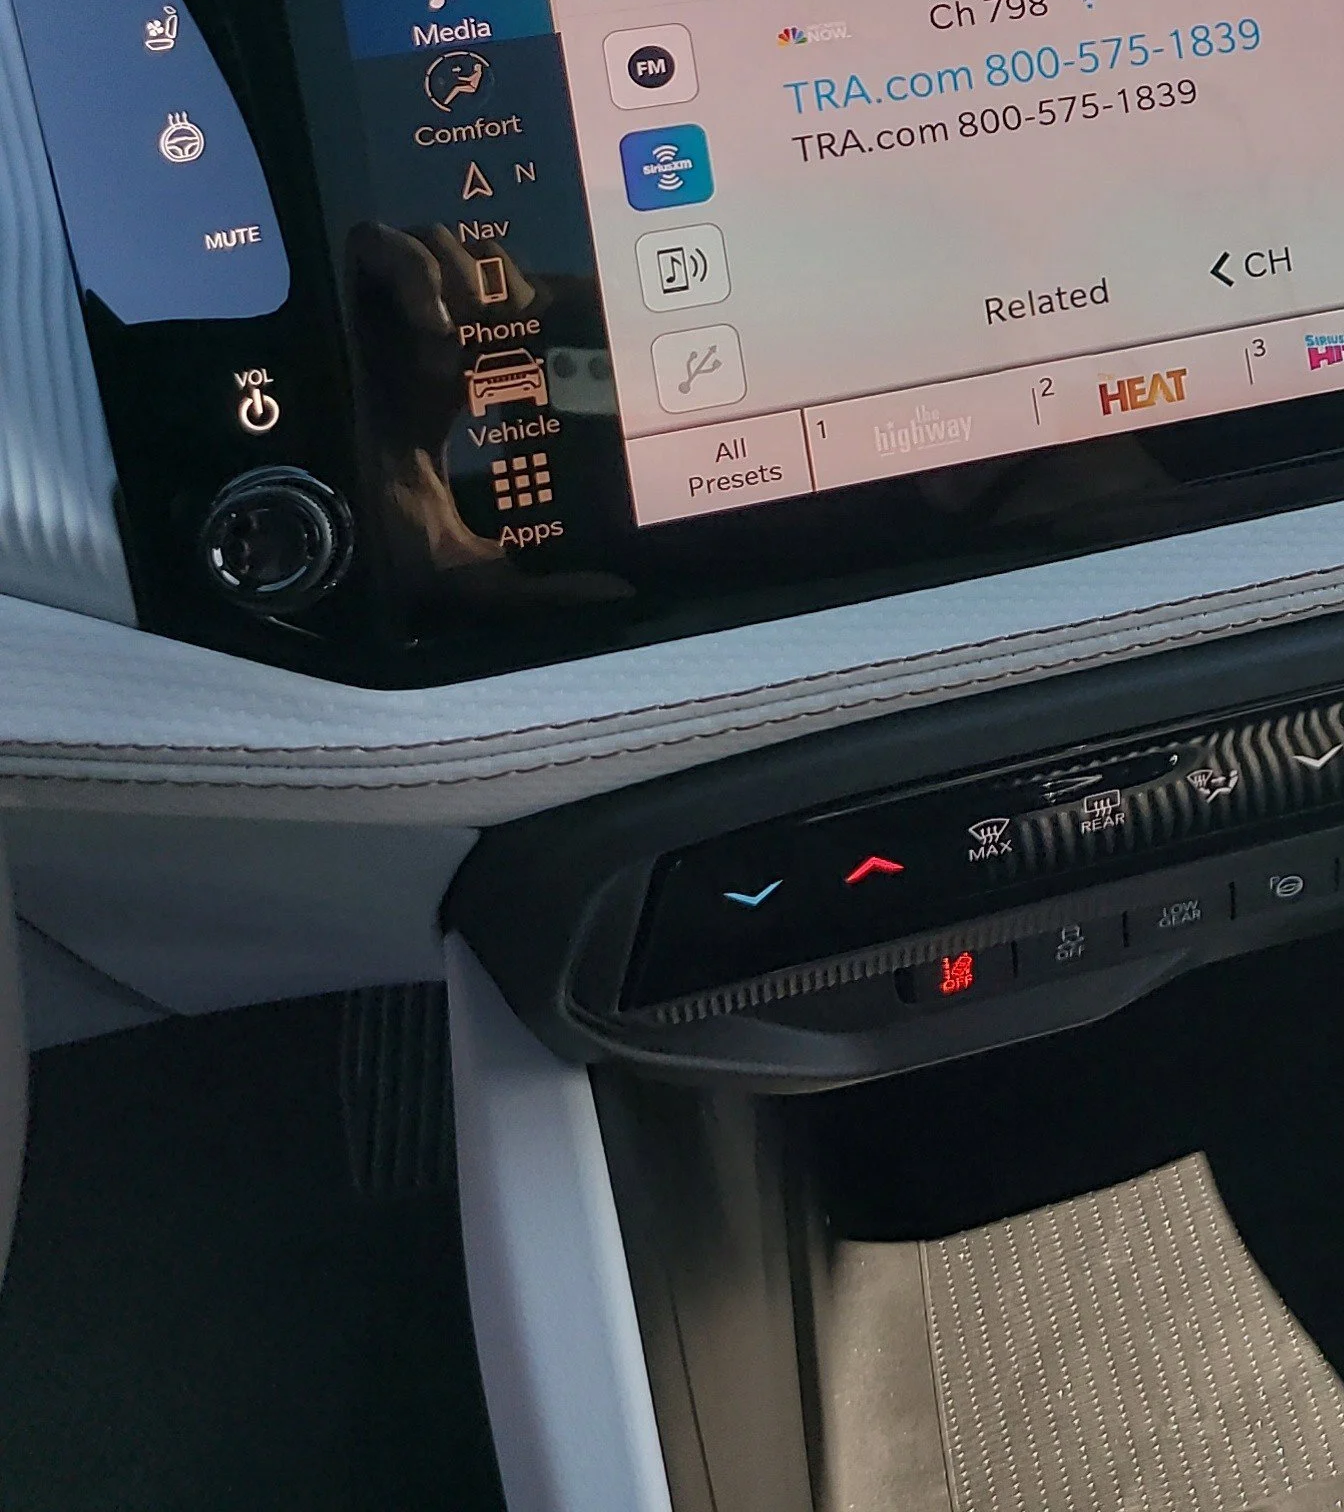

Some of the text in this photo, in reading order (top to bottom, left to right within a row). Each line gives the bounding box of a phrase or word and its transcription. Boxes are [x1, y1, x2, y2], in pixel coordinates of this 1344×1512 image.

[930, 1, 975, 30] Ch
[414, 18, 493, 48] Media
[637, 57, 667, 76] FM
[783, 18, 1262, 116] TRA.com 800-575-1839
[415, 113, 523, 146] Comfort
[792, 78, 1198, 163] TRA.com 800-575-1839
[516, 161, 536, 185] N
[205, 226, 263, 252] MUTE
[459, 217, 511, 242] Nav
[1244, 246, 1292, 279] CH
[984, 278, 1110, 325] Related
[460, 315, 541, 346] Phone
[1252, 339, 1267, 358] 3
[234, 369, 274, 389] VOL
[1039, 377, 1056, 397] 2
[1098, 368, 1187, 416] HEAT
[469, 414, 561, 446] Vehicle
[816, 421, 828, 439] 1
[874, 416, 972, 454] highway
[715, 435, 748, 463] All
[688, 463, 783, 498] Presets
[499, 518, 564, 549] Apps
[1081, 812, 1126, 834] REAR
[968, 839, 1013, 862] MAX
[1158, 909, 1201, 928] GEAR
[1162, 900, 1199, 918] LOW
[1055, 944, 1086, 961] OFF
[941, 974, 974, 994] OFF
